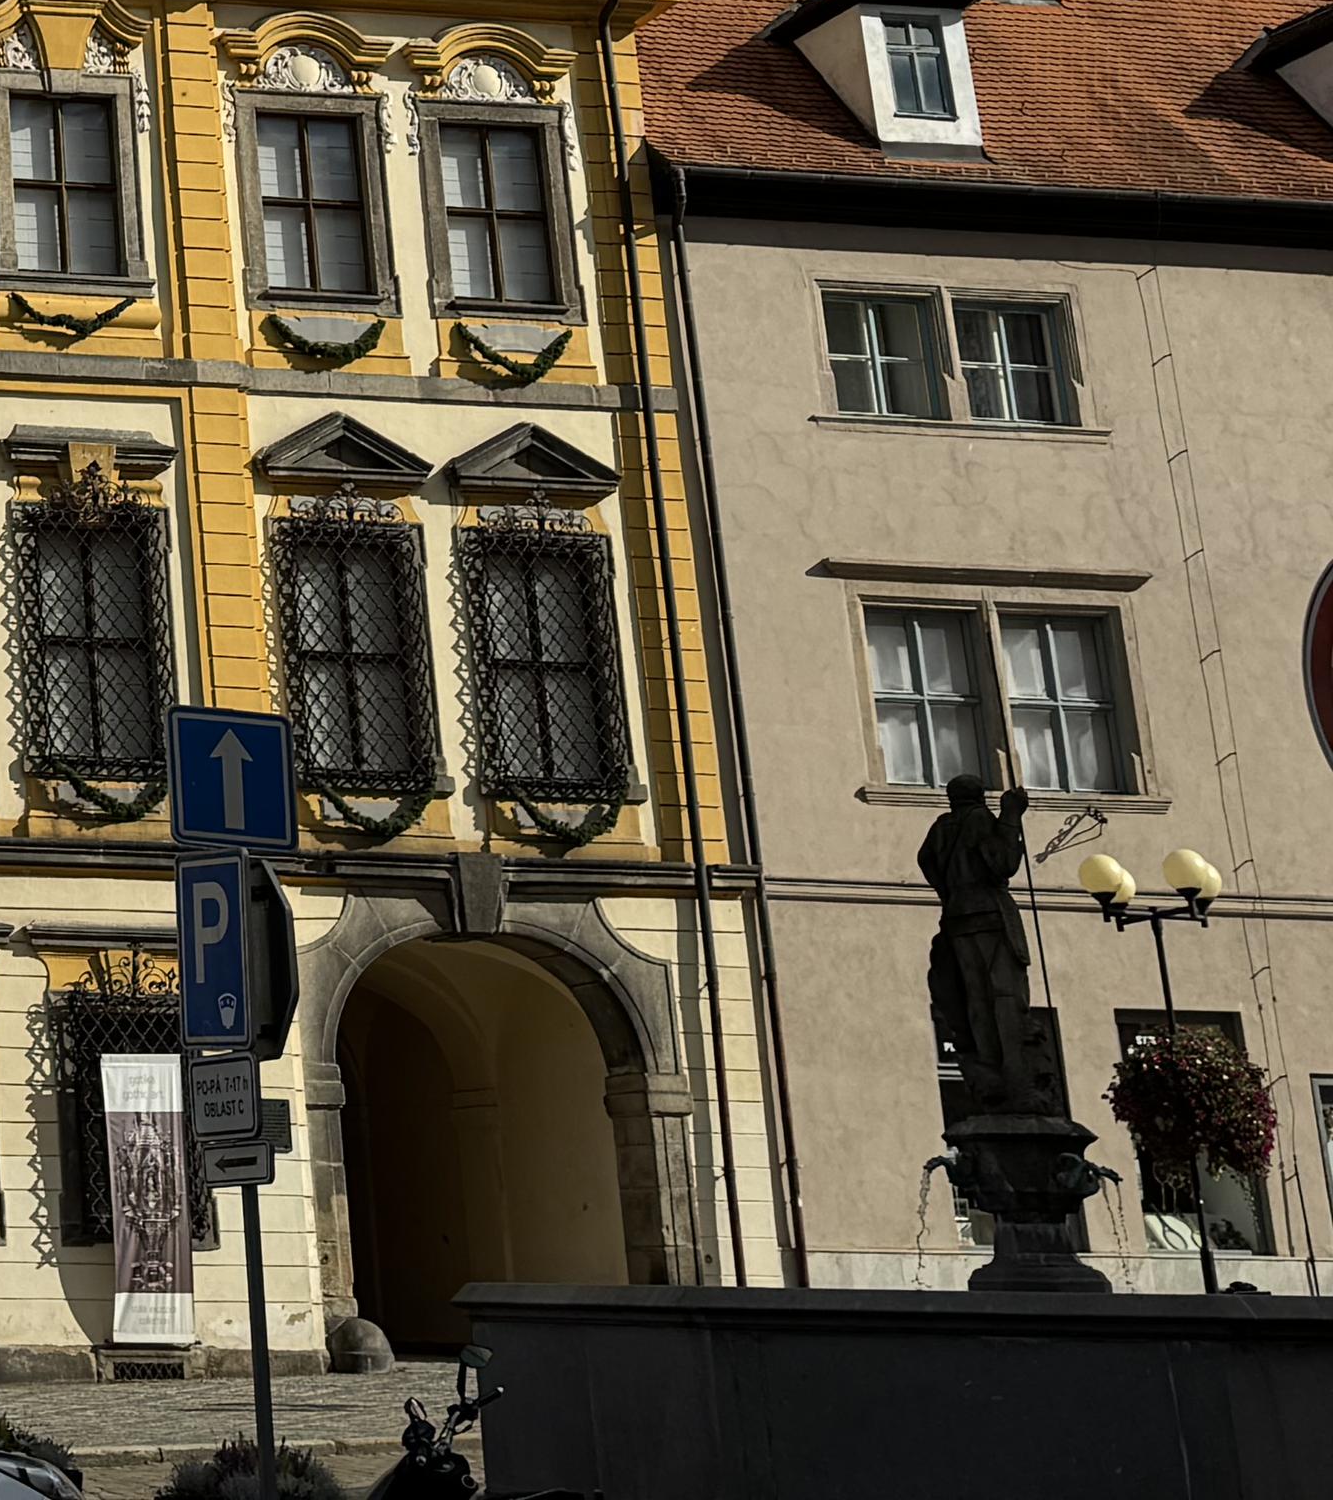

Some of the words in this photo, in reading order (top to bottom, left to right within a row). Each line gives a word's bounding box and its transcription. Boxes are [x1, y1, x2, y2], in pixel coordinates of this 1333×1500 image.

[193, 881, 229, 984] P
[197, 1074, 221, 1096] PO-PÁ
[225, 1076, 241, 1092] 7-17
[243, 1075, 249, 1091] h
[204, 1100, 237, 1117] OBLAST
[238, 1099, 244, 1114] C
